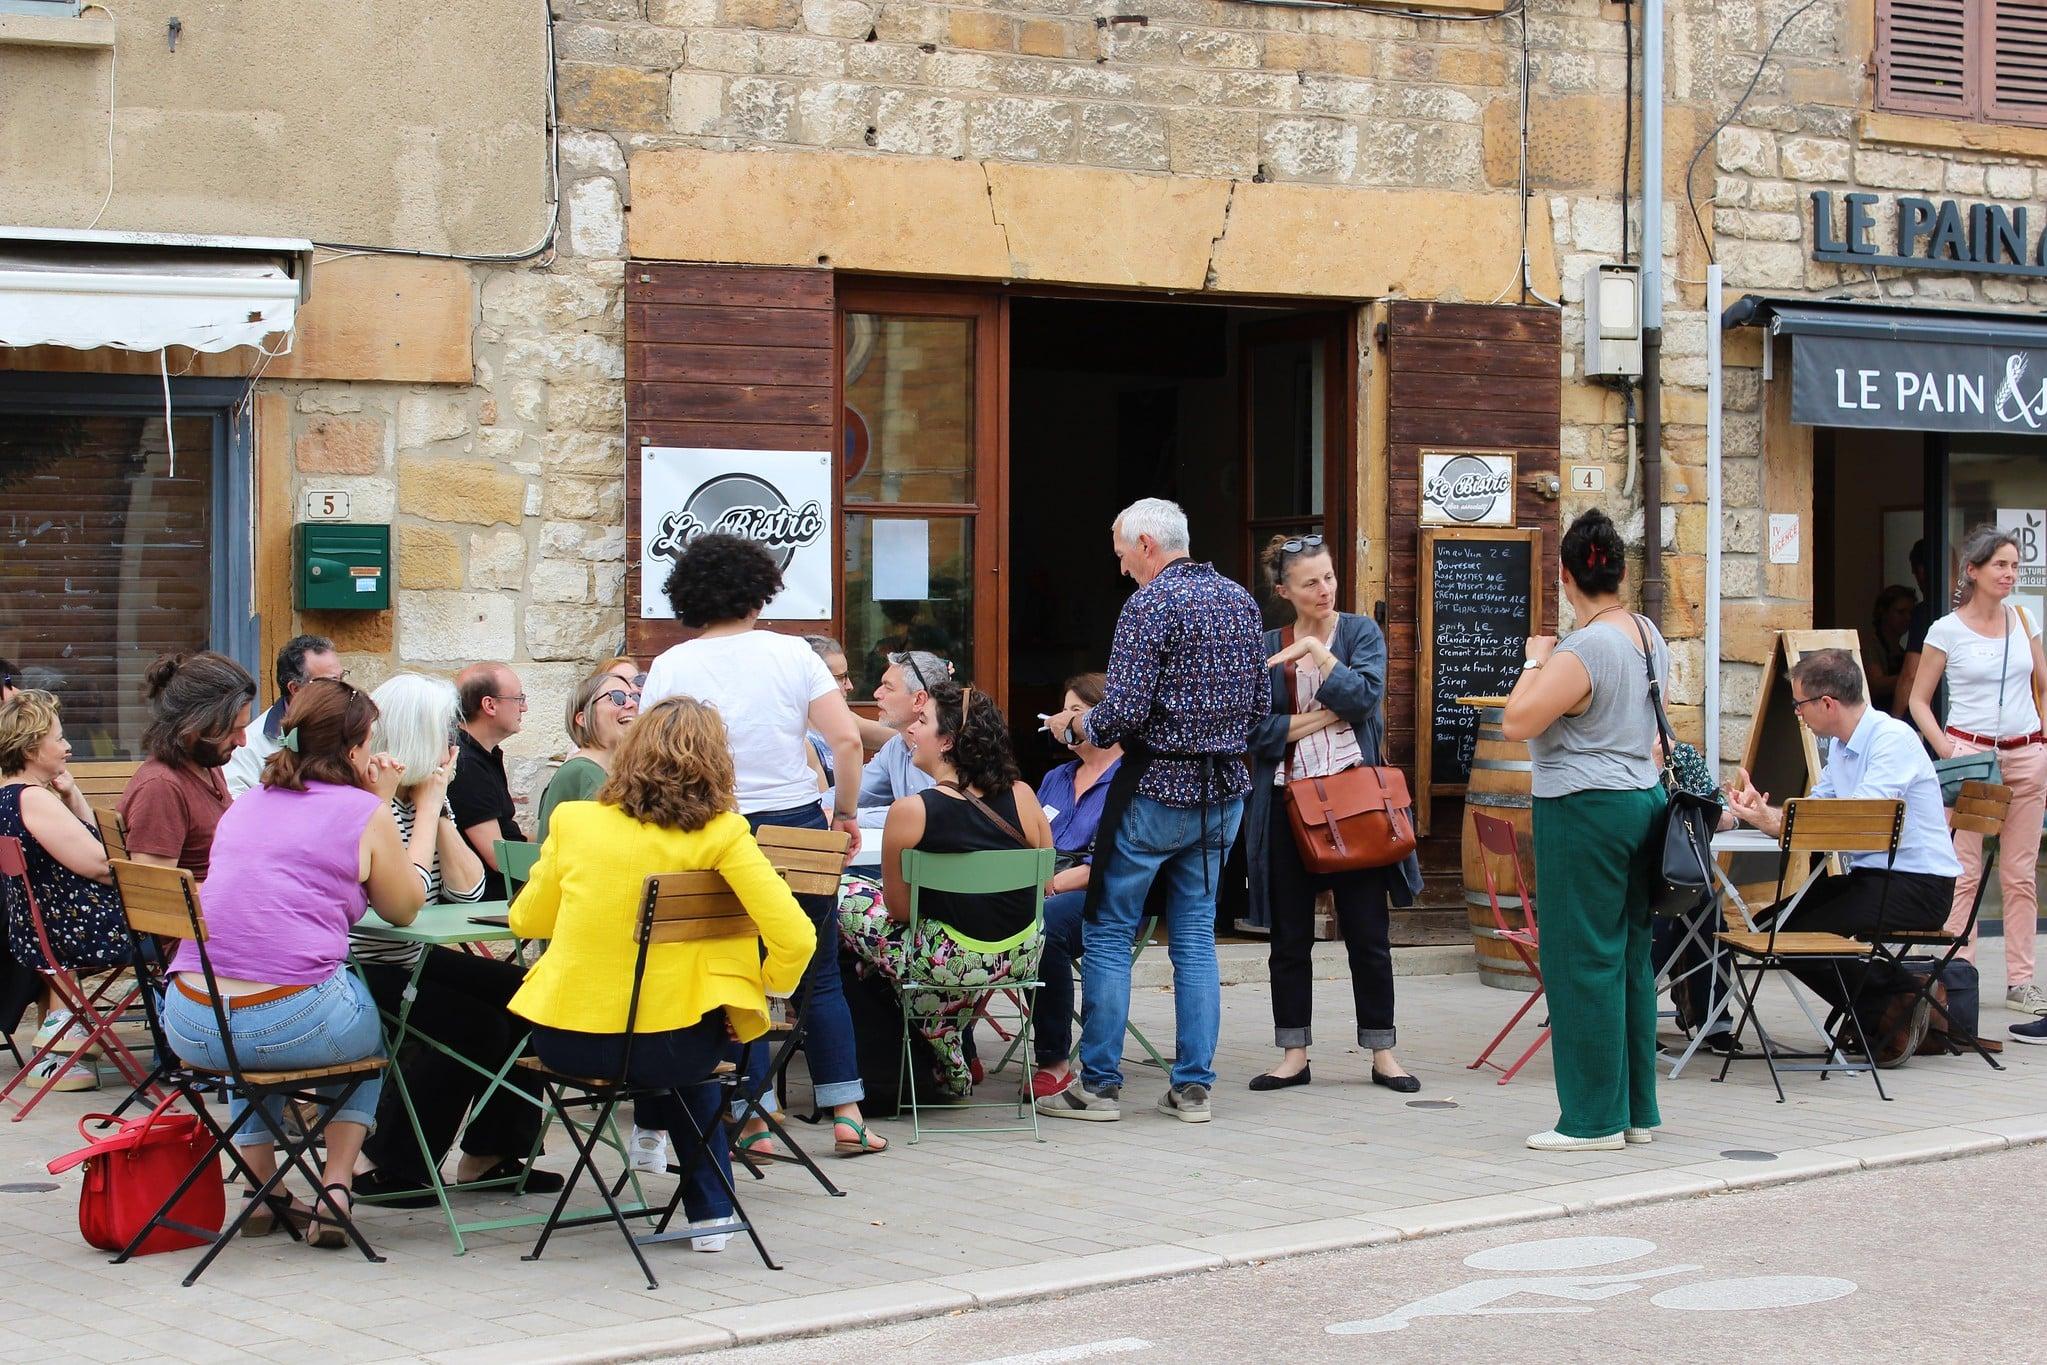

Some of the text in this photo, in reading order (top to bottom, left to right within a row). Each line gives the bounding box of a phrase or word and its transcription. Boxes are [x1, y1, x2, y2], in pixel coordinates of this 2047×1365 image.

[1810, 190, 1879, 254] LE
[1897, 197, 2027, 266] PAIN
[1835, 368, 1881, 409] LE
[1895, 372, 1984, 414] PAIN
[1583, 471, 1593, 488] 4
[1424, 472, 1511, 504] Le Bistrô
[323, 495, 335, 515] 5
[711, 502, 823, 545] Bistrô
[1490, 549, 1497, 558] 2
[2018, 567, 2046, 576] ULTURE
[2020, 576, 2046, 585] GIQUE
[1438, 664, 1459, 675] Jus
[1462, 664, 1471, 672] de
[1437, 676, 1467, 688] Sirop
[1436, 703, 1474, 714] Cannette
[1459, 716, 1474, 728] 0%
